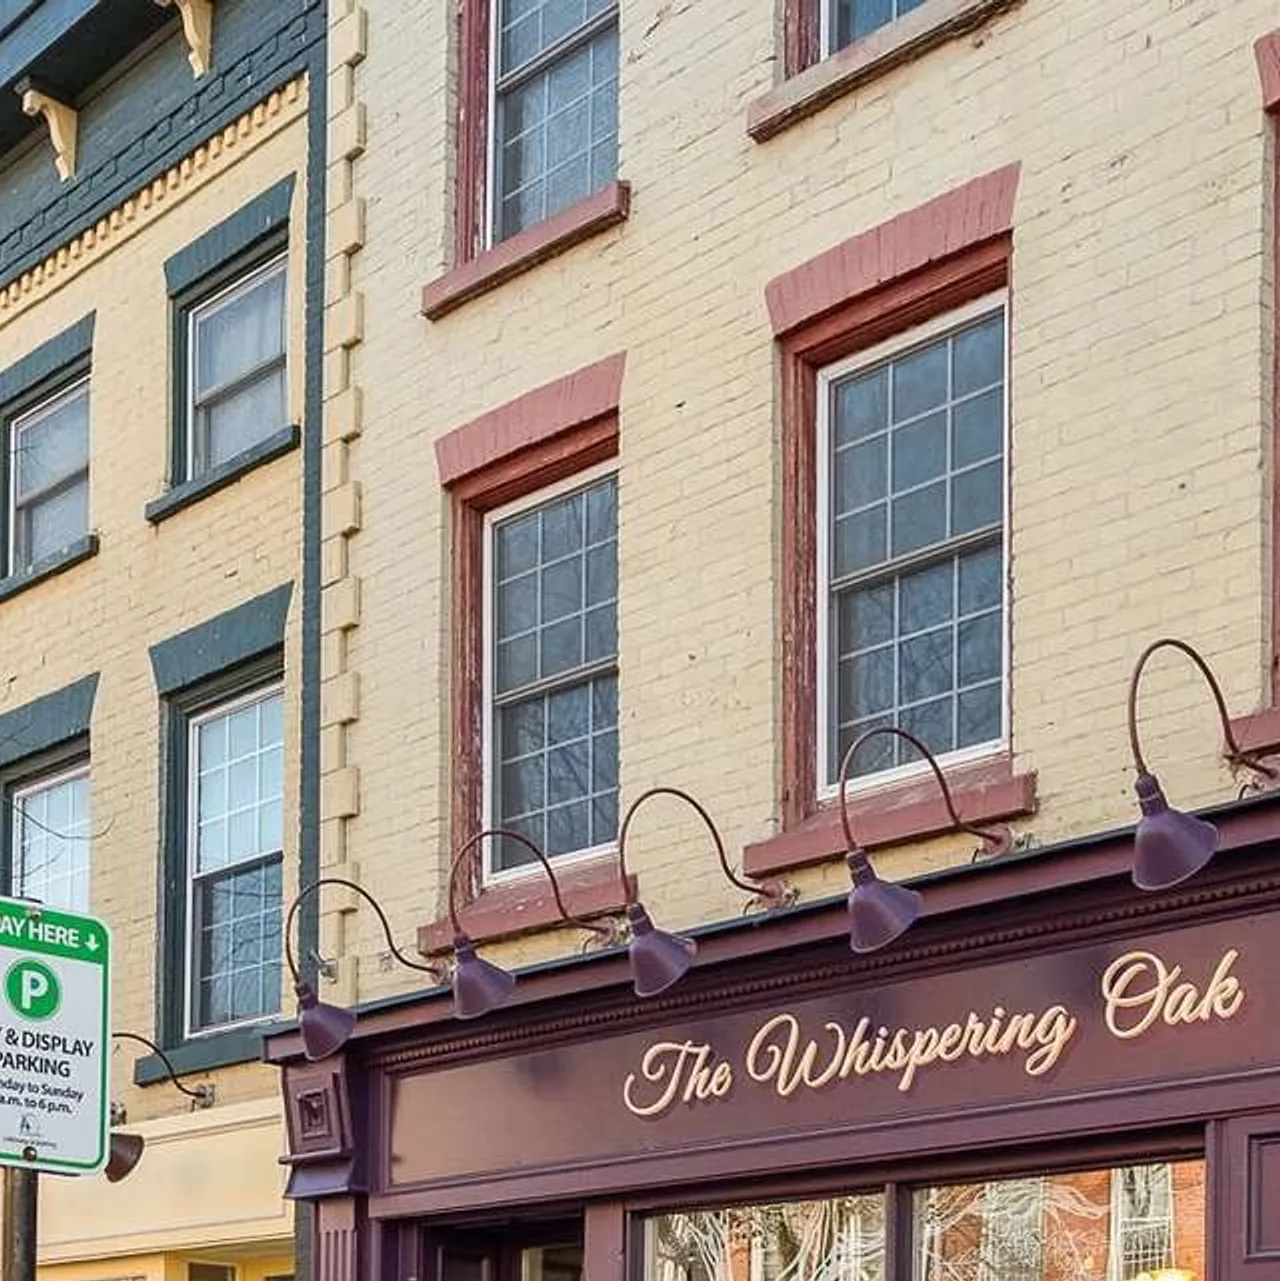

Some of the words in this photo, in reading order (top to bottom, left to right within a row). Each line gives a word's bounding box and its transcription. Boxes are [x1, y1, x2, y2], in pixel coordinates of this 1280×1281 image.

[28, 922, 79, 948] HERE
[21, 969, 49, 1009] P
[5, 1029, 20, 1046] &
[22, 1031, 94, 1058] DISPLAY
[624, 1041, 731, 1115] The
[746, 1004, 1076, 1096] Whispering
[1101, 947, 1246, 1039] Oak
[25, 1098, 37, 1110] to
[38, 1099, 46, 1111] 6
[28, 1081, 40, 1094] to
[41, 1083, 83, 1103] Sunday
